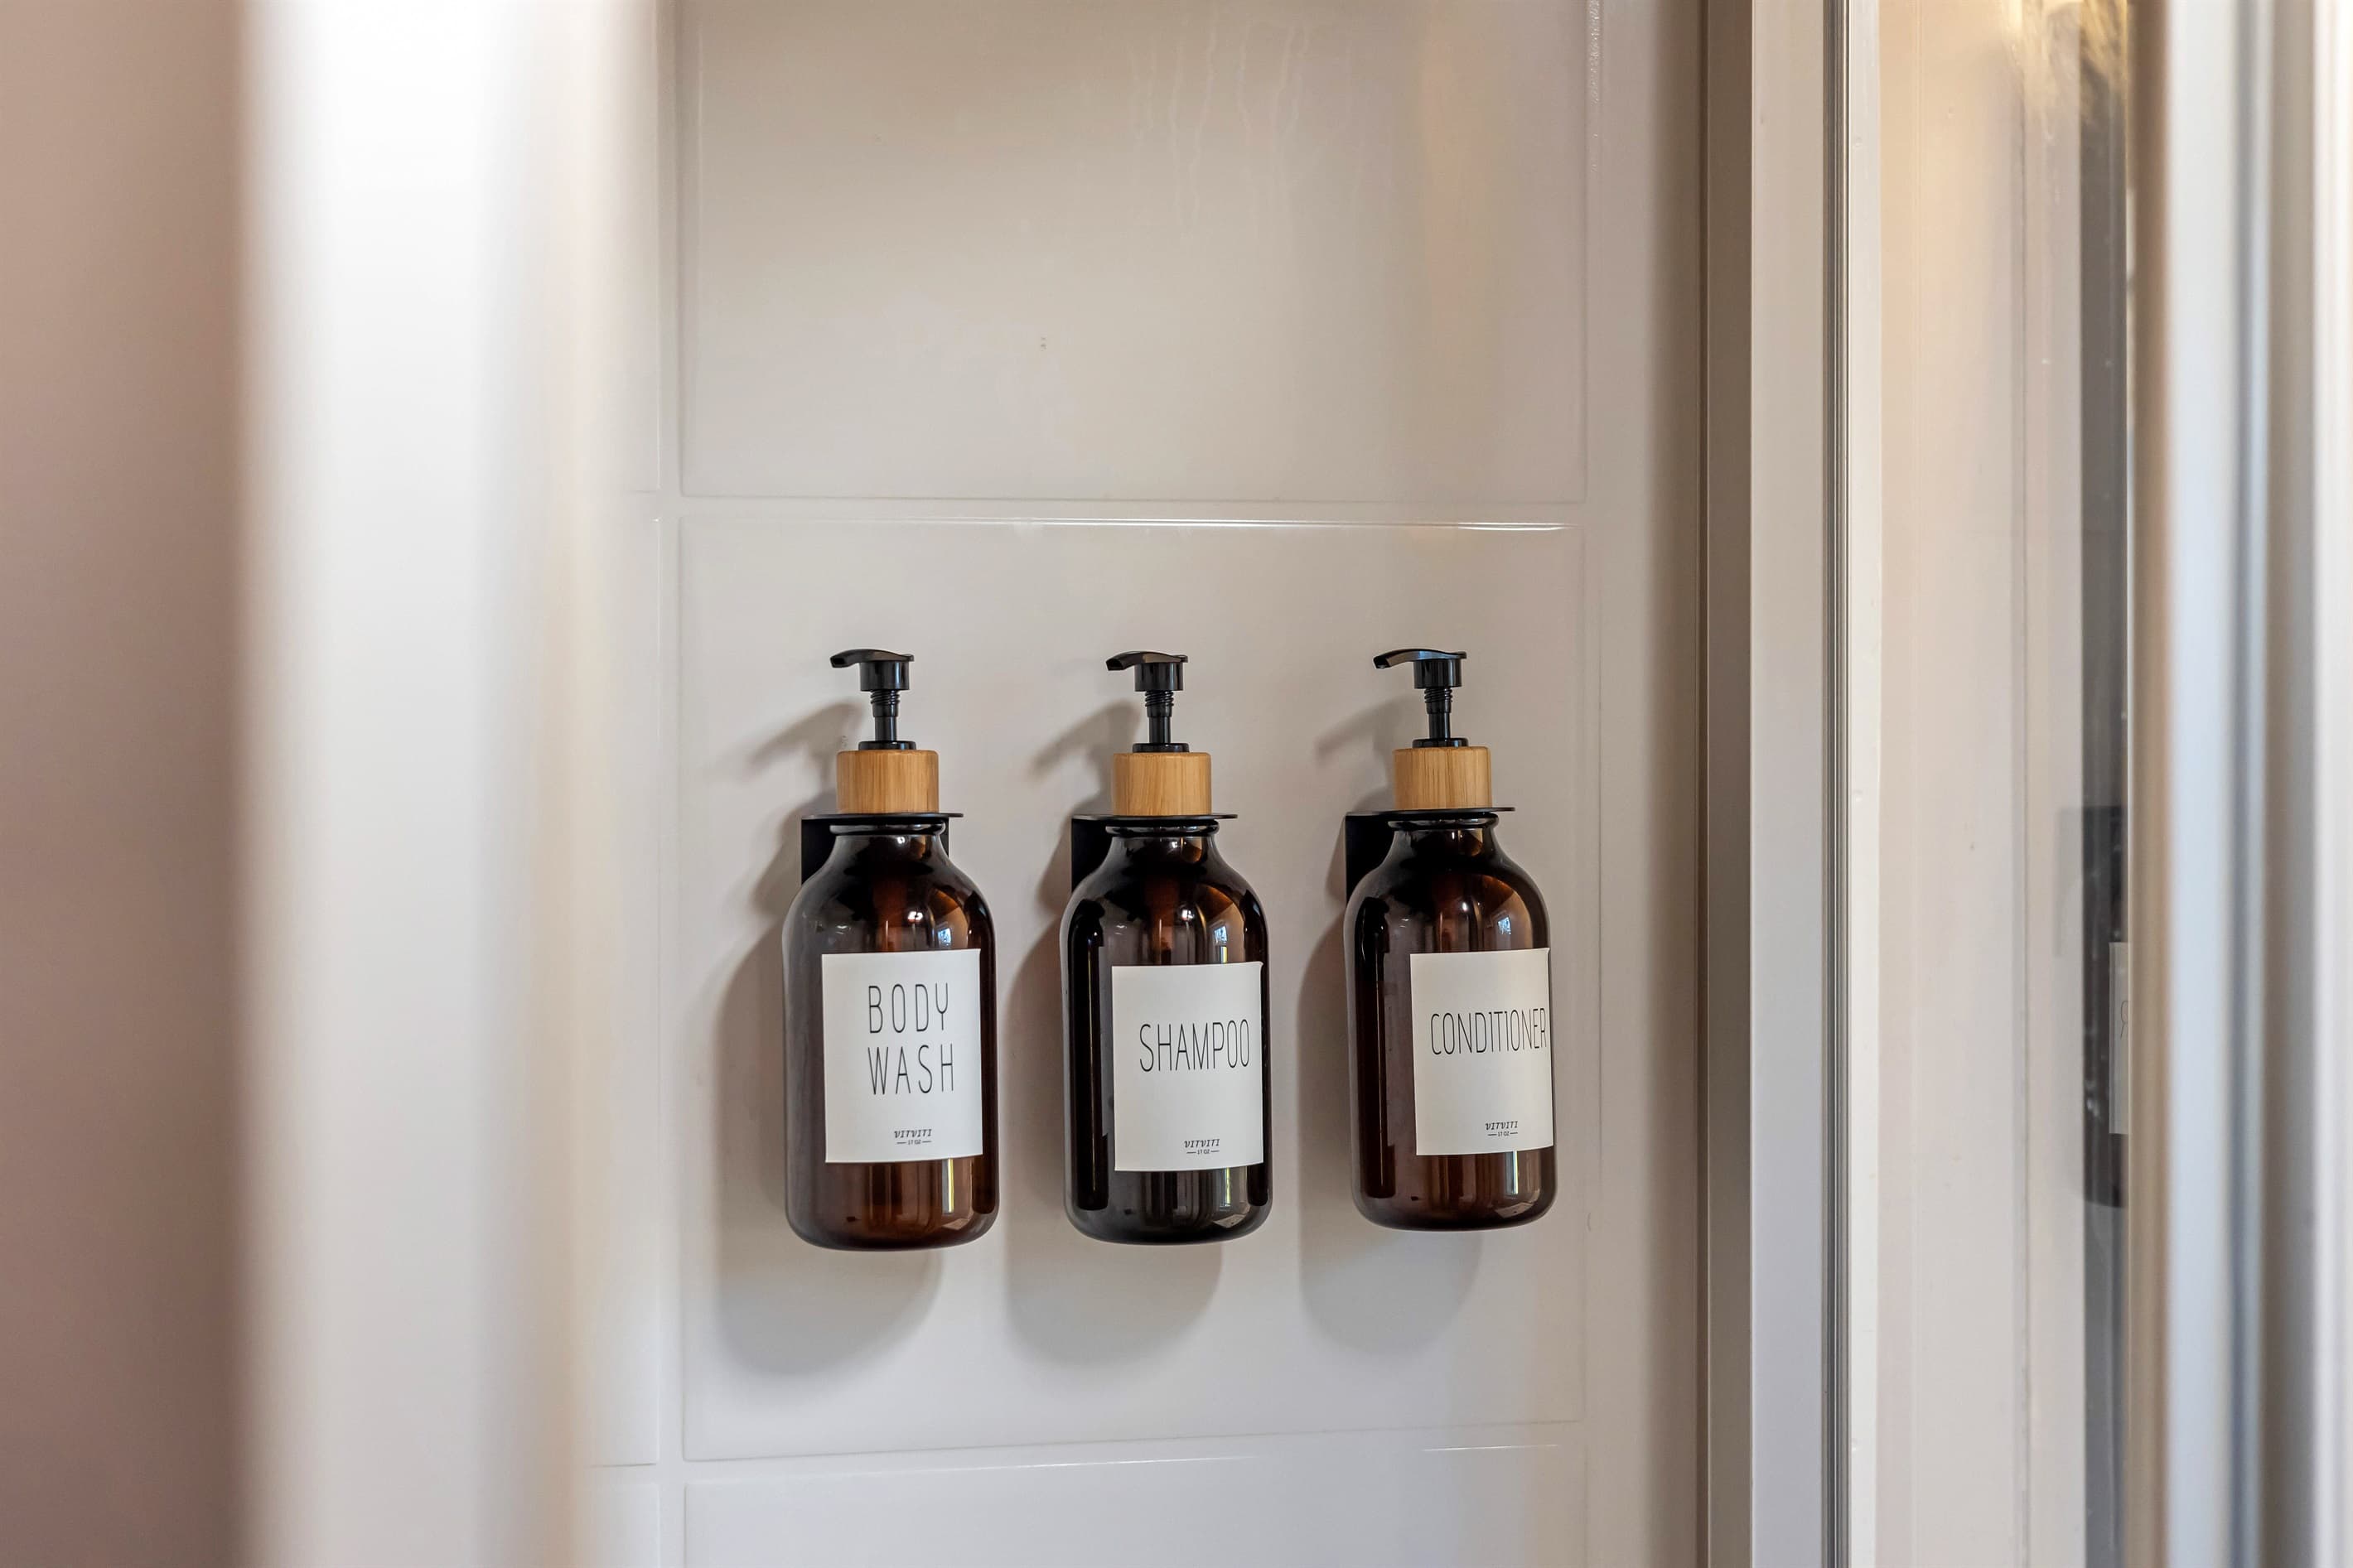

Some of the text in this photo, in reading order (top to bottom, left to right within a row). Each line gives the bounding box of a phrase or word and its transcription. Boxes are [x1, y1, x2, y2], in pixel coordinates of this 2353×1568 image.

[868, 982, 949, 1034] BODY
[1431, 1007, 1547, 1055] CONDITIONER
[867, 1043, 954, 1095] WASH
[1139, 1019, 1250, 1072] SHAMPOO
[894, 1128, 932, 1139] VITVITI
[1184, 1138, 1220, 1148] VITVITI
[1485, 1121, 1519, 1131] VITVITI
